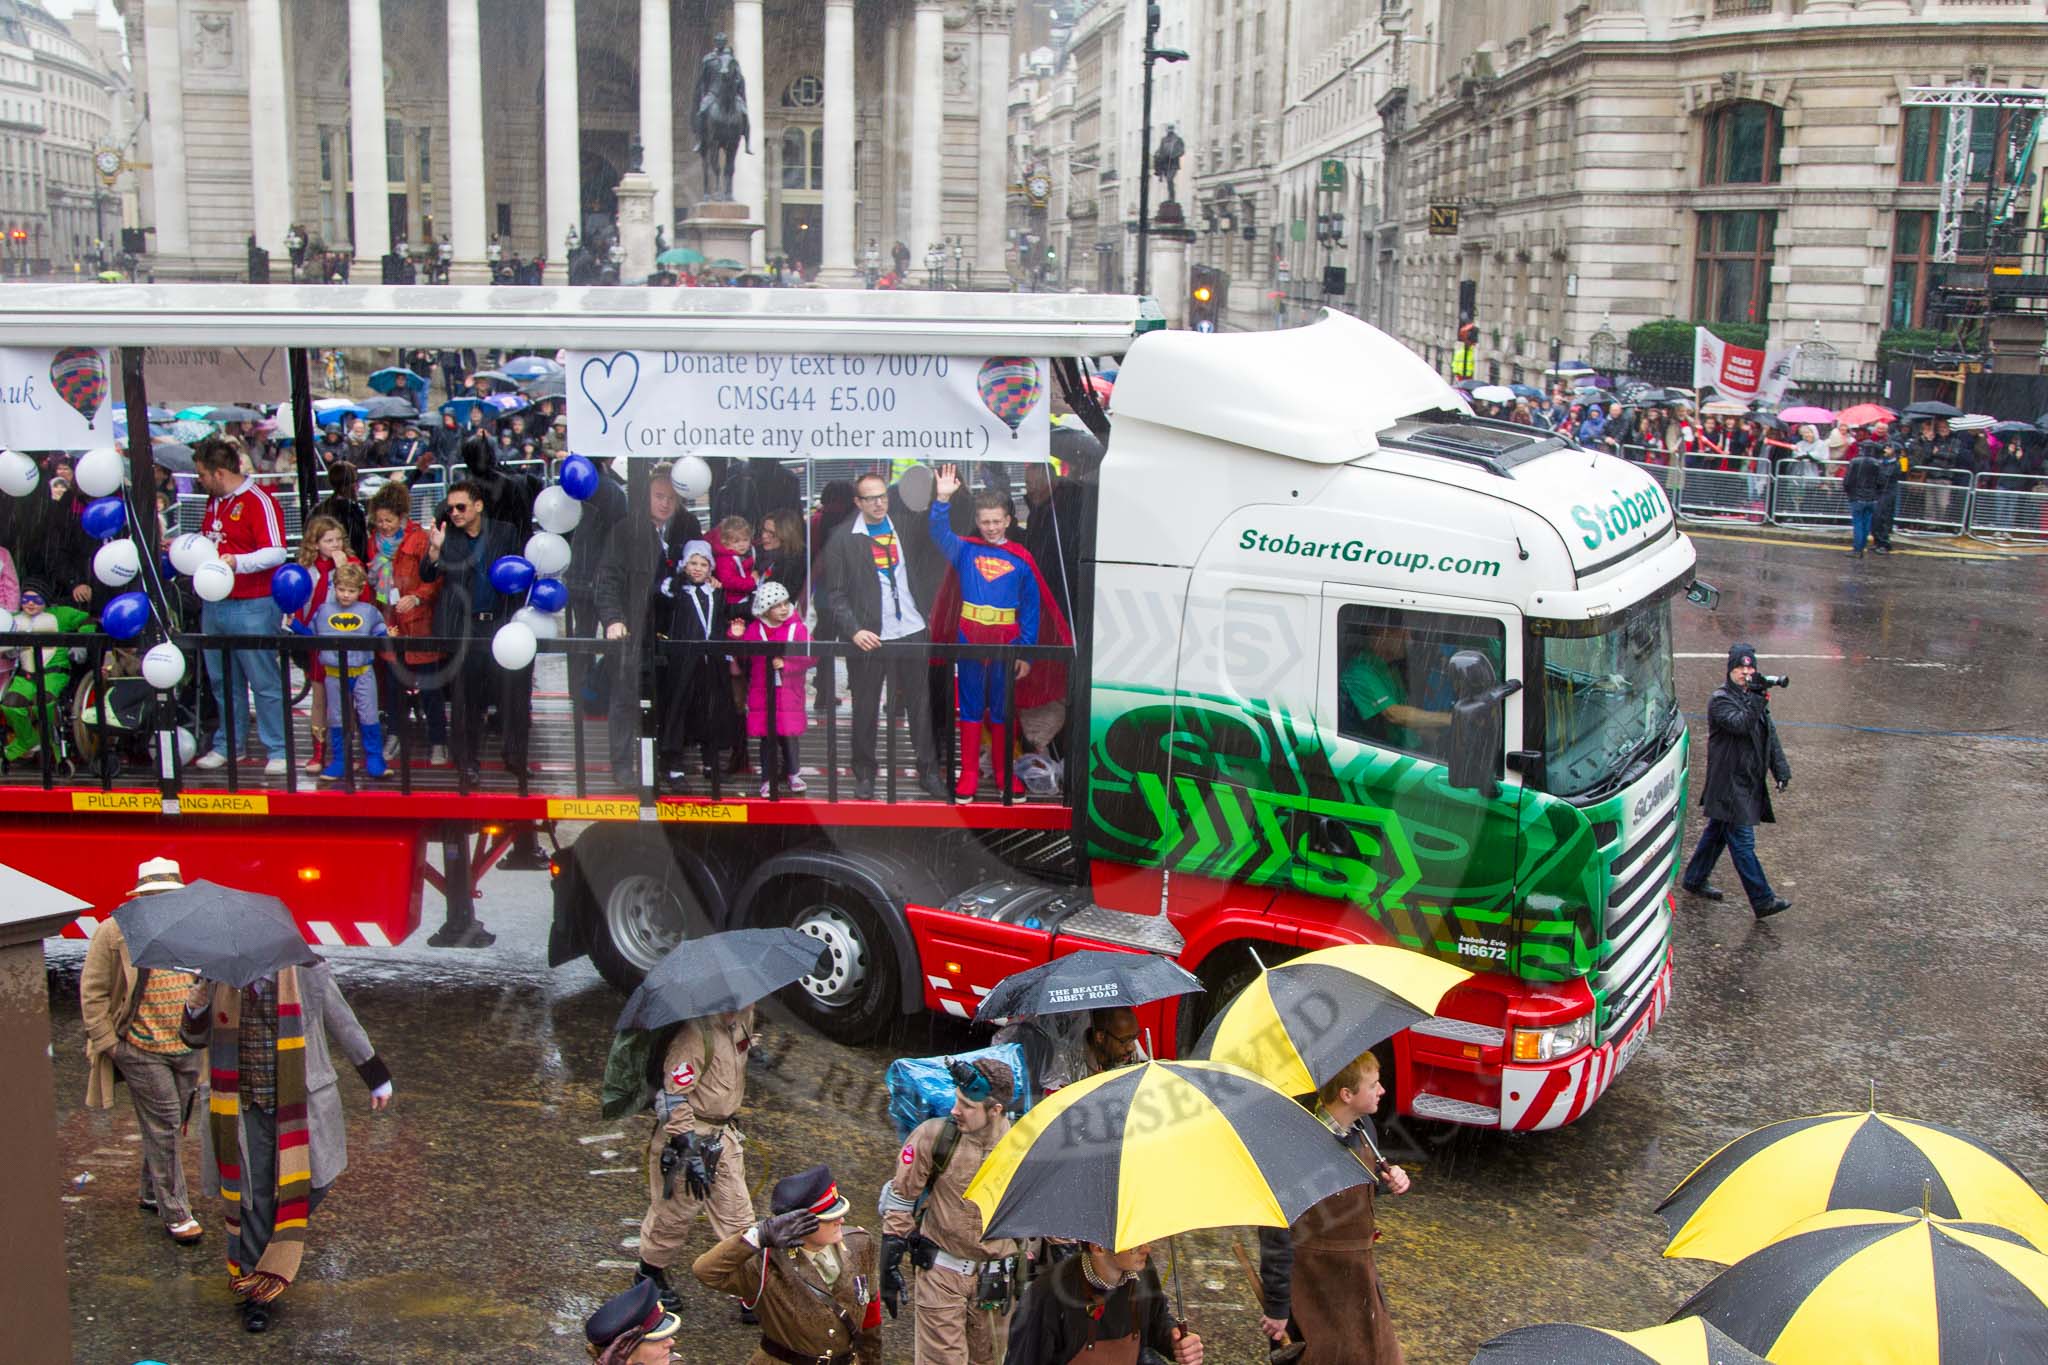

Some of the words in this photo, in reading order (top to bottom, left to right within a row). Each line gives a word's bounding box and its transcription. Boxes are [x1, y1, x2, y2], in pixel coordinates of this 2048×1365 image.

[663, 350, 747, 374] Donate
[756, 352, 783, 381] by
[791, 353, 835, 376] text
[843, 354, 865, 376] to
[870, 354, 949, 378] 70070
[717, 385, 816, 411] CMSG44
[830, 386, 896, 412] £5.00
[641, 426, 667, 446] or
[673, 421, 755, 447] donate
[762, 429, 804, 453] any
[811, 422, 876, 448] other
[882, 427, 974, 449] amount
[1570, 483, 1666, 551] Stobart
[1239, 528, 1501, 577] StobartGroup.com
[88, 796, 138, 808] PILLAR
[143, 796, 209, 809] PAING
[211, 798, 253, 810] AREA
[563, 803, 615, 815] PILLAR
[620, 804, 687, 817] PAING
[689, 805, 732, 818] AREA
[1458, 942, 1506, 960] H6672
[1048, 988, 1070, 997] THE
[1072, 983, 1118, 995] BEATLES
[1049, 993, 1085, 1004] ABBEY
[1089, 989, 1119, 1000] ROAD
